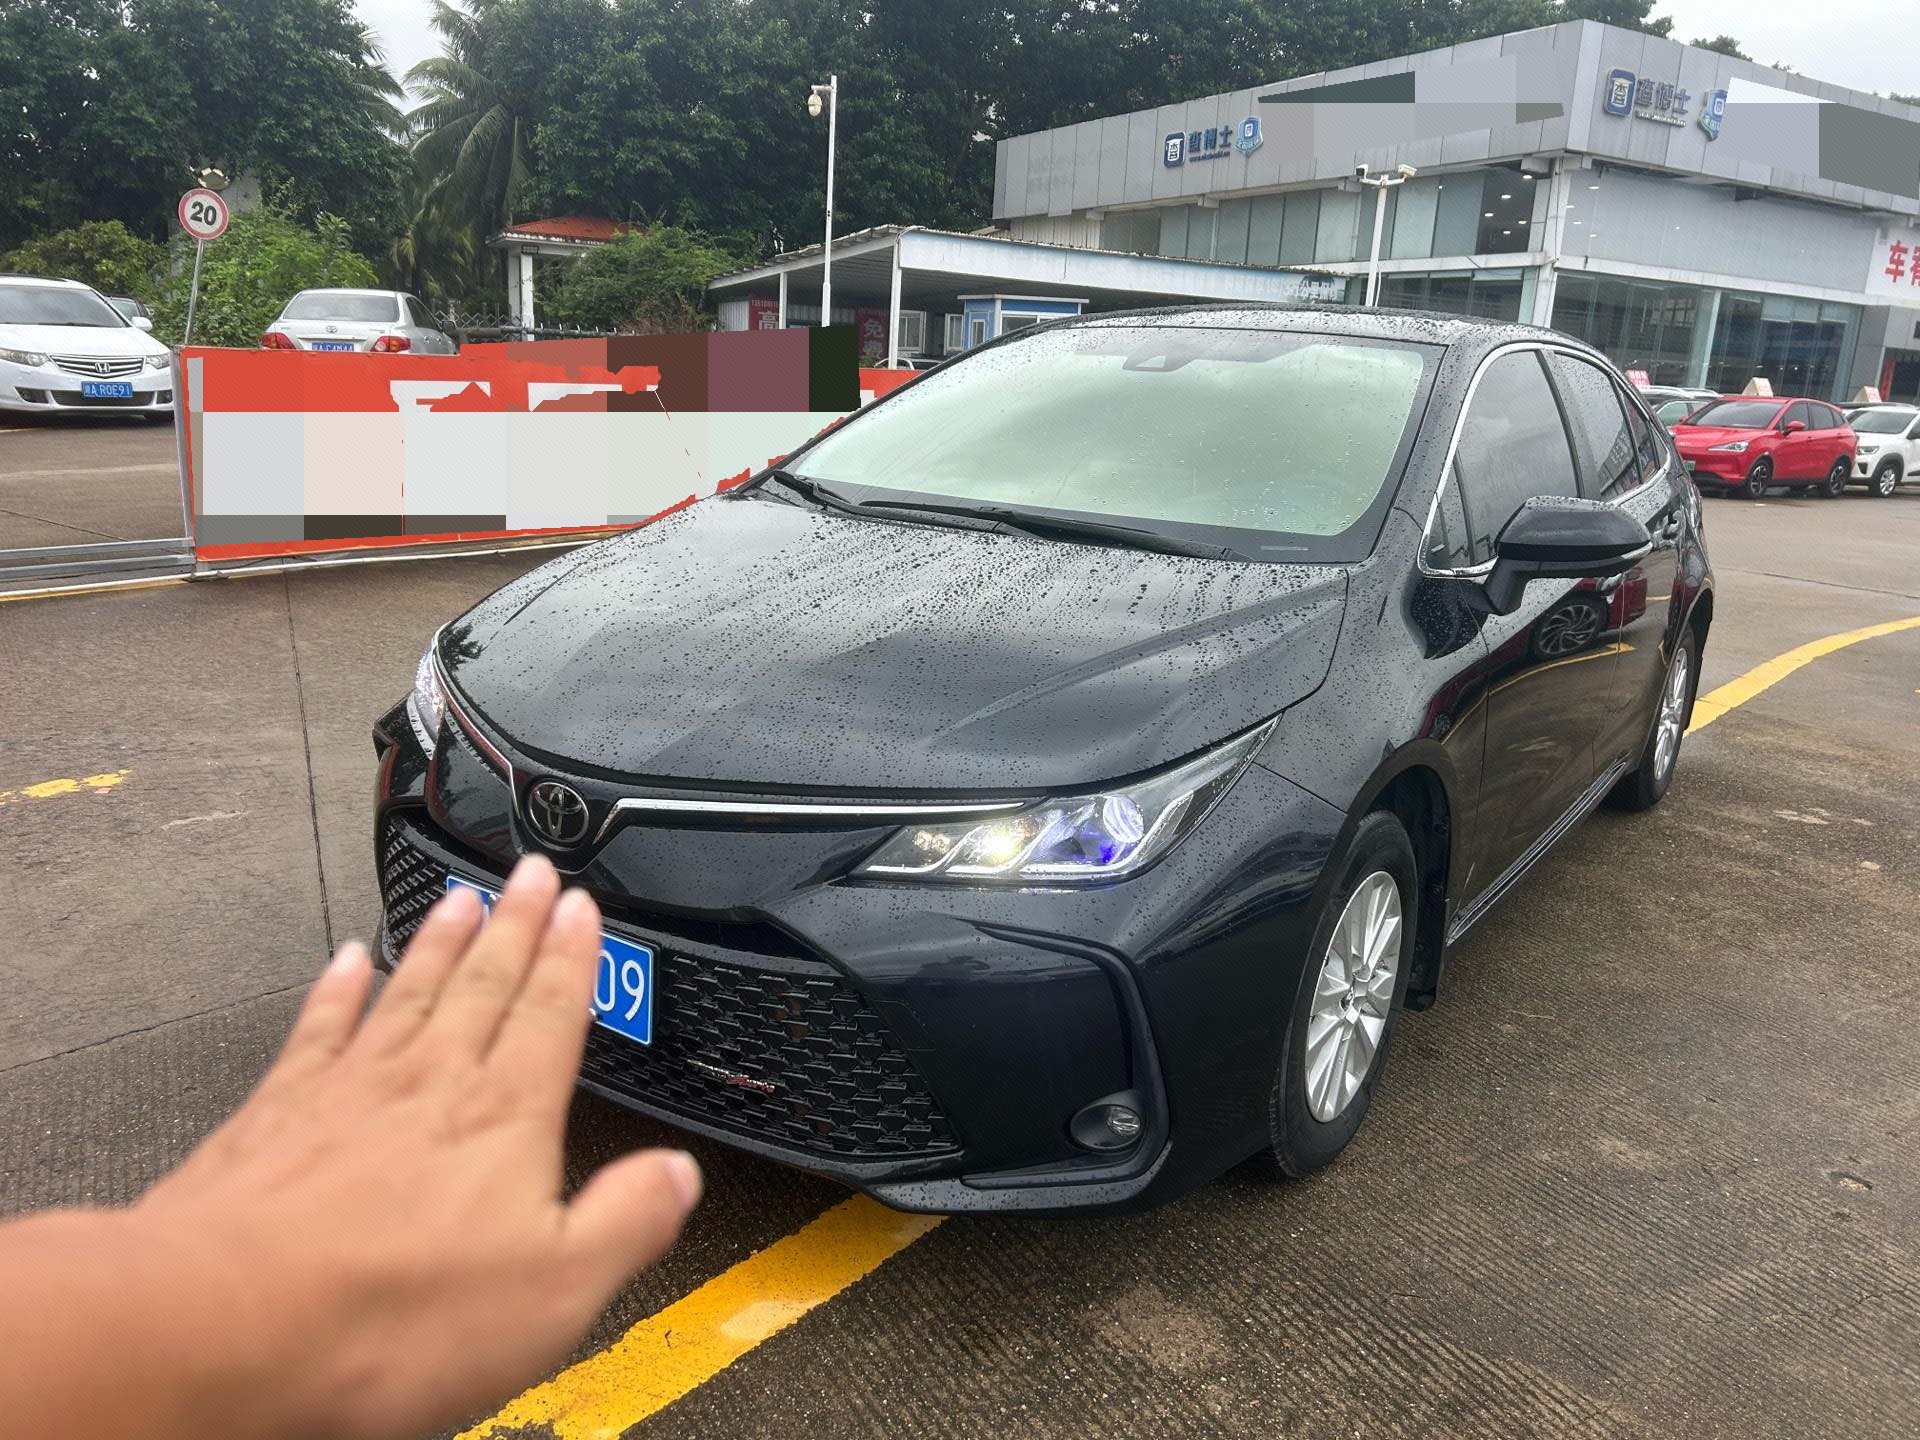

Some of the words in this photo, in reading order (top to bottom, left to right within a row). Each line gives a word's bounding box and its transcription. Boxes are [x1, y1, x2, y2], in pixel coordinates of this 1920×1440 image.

[1636, 79, 1691, 114] 查博士
[1188, 125, 1233, 153] 查博士
[190, 201, 217, 226] 20
